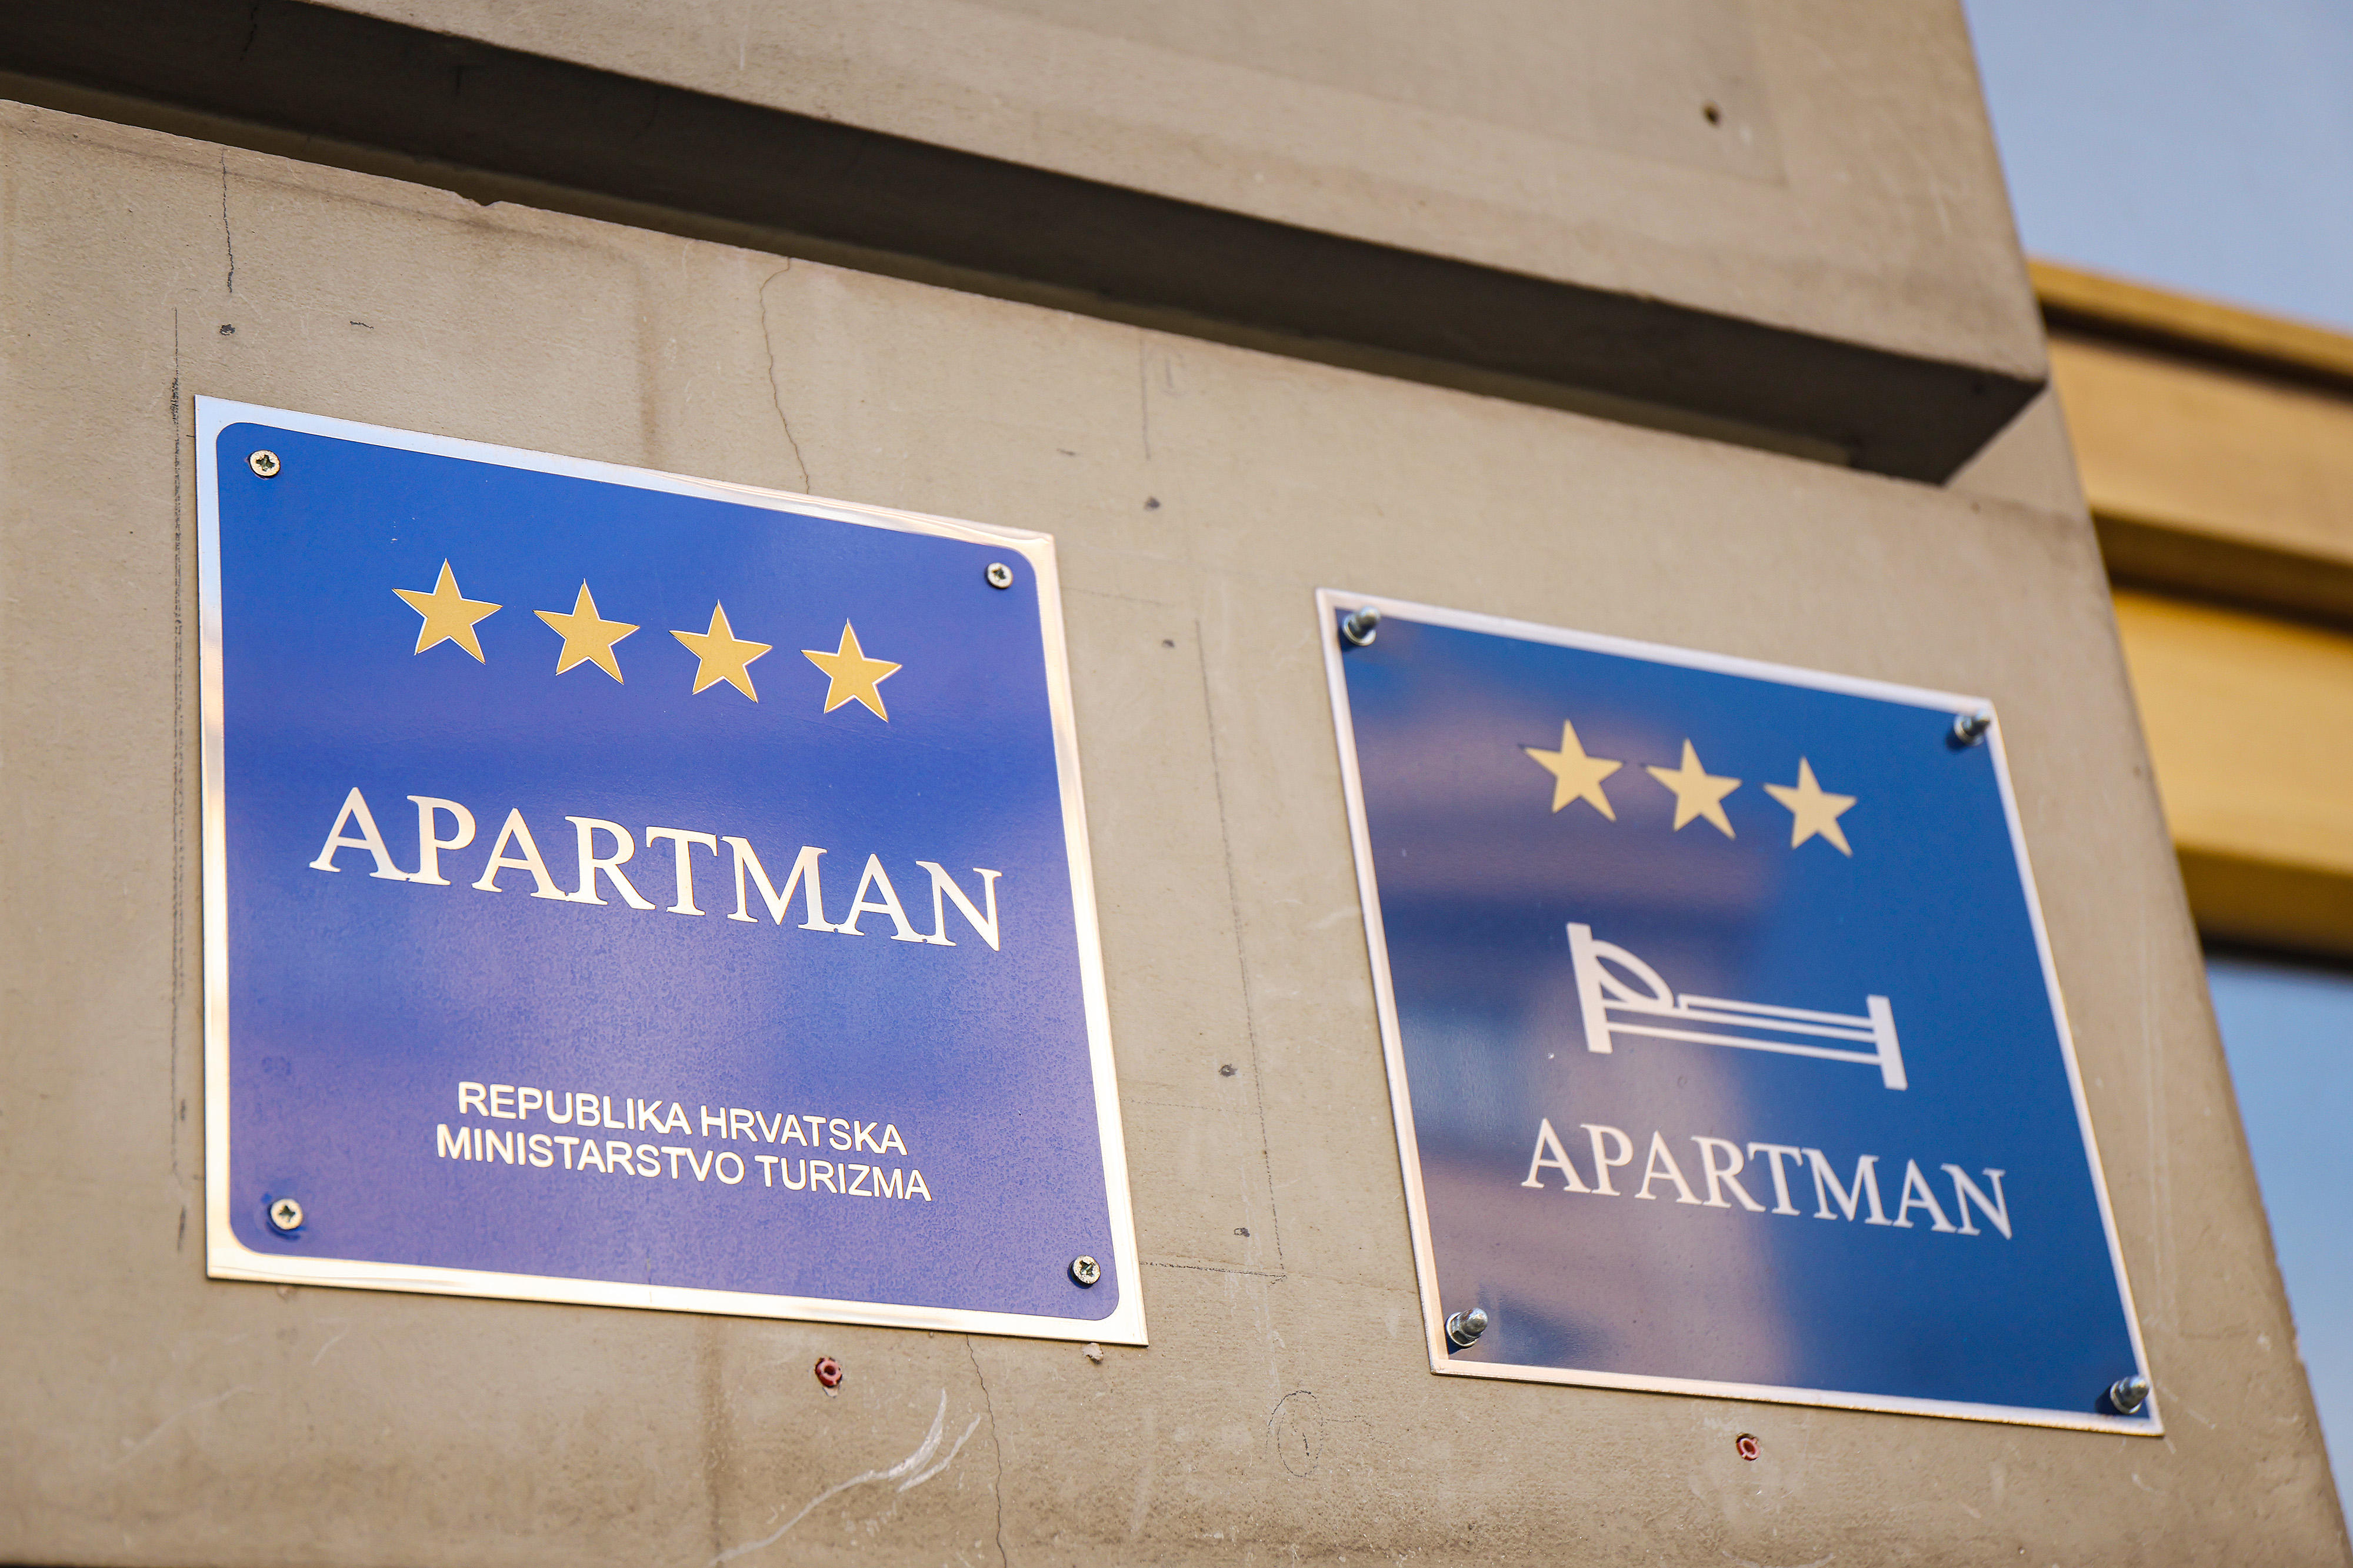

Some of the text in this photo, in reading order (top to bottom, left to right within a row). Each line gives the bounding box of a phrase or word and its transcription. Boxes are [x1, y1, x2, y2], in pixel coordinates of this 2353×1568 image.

[309, 788, 1002, 951] APARTMAN
[437, 1124, 932, 1201] MINISTARSTVO TURIZMA
[459, 1082, 907, 1155] REPUBLIKA HRVATSKA
[1521, 1117, 2012, 1239] APARTMAN
